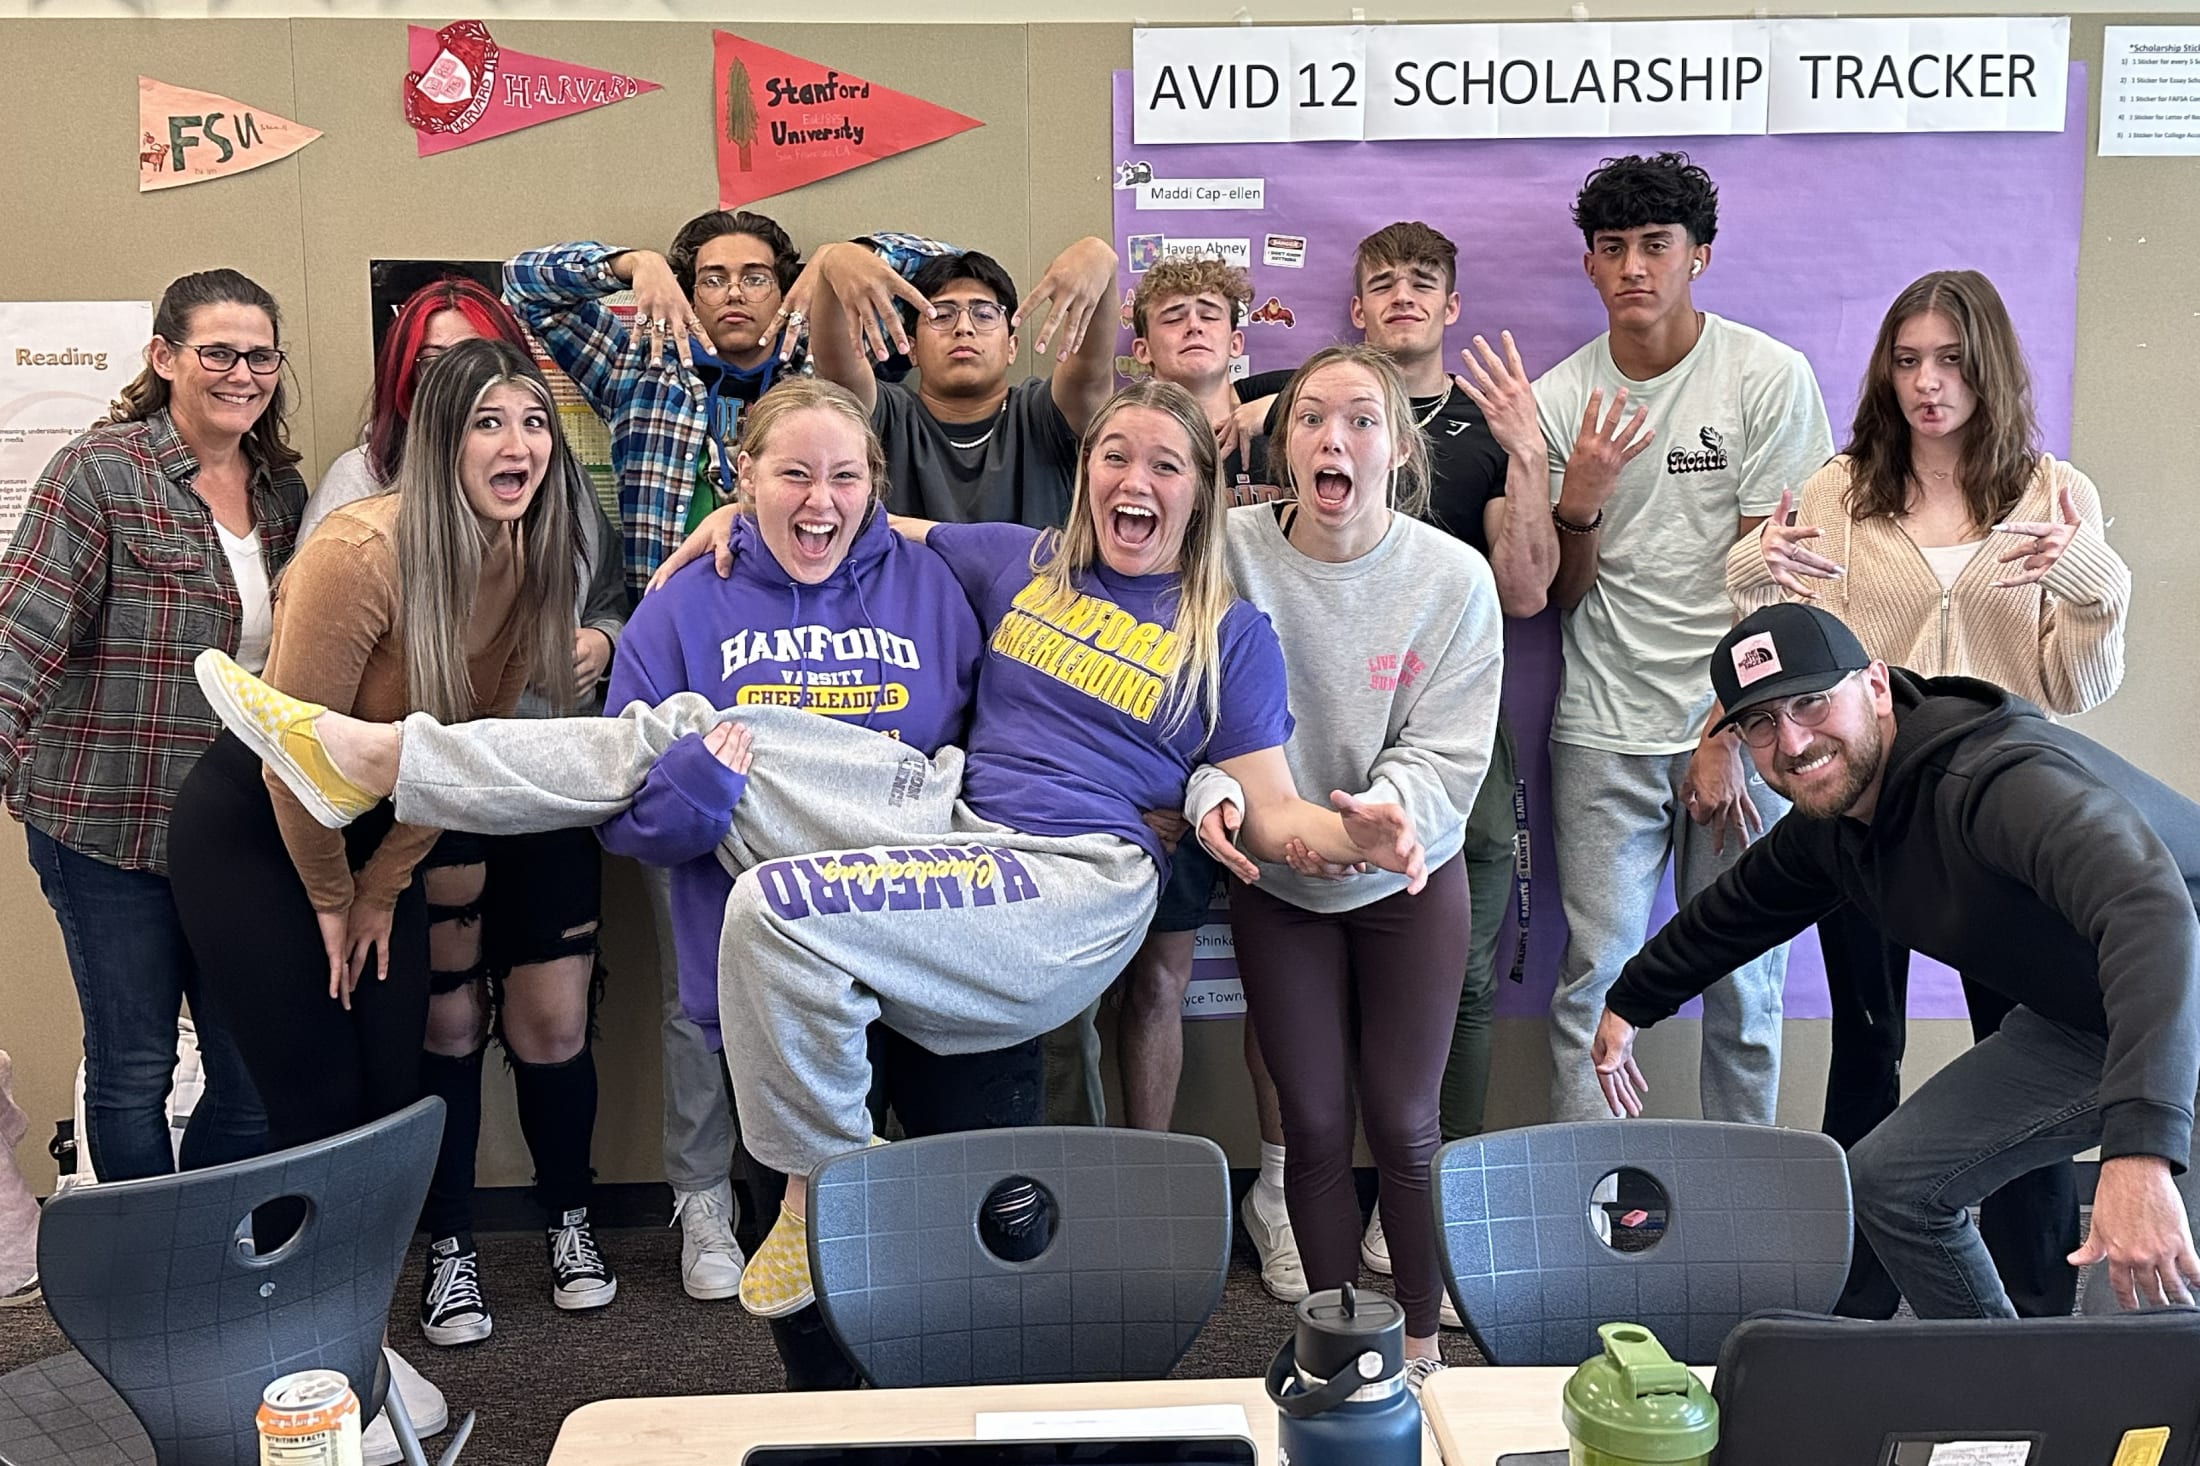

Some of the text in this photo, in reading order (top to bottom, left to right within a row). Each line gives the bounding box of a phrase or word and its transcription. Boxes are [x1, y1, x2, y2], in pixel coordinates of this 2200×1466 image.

[503, 74, 637, 108] HARVARD
[766, 72, 869, 107] Stanford
[1150, 54, 2037, 110] AVID 12 SCHOLARSHIP TRACKER
[451, 79, 492, 131] HARVARD
[771, 117, 864, 145] University
[1151, 186, 1261, 202] Maddi Cap-ellen
[1205, 241, 1247, 257] Abney
[16, 347, 108, 370] Reading
[720, 625, 921, 682] HANFORD
[992, 609, 1165, 724] CHEERLEADING
[781, 669, 864, 685] VARSITY
[748, 689, 899, 709] CHEERLEADING
[822, 854, 995, 889] Cheerleading
[1184, 994, 1205, 1008] yce
